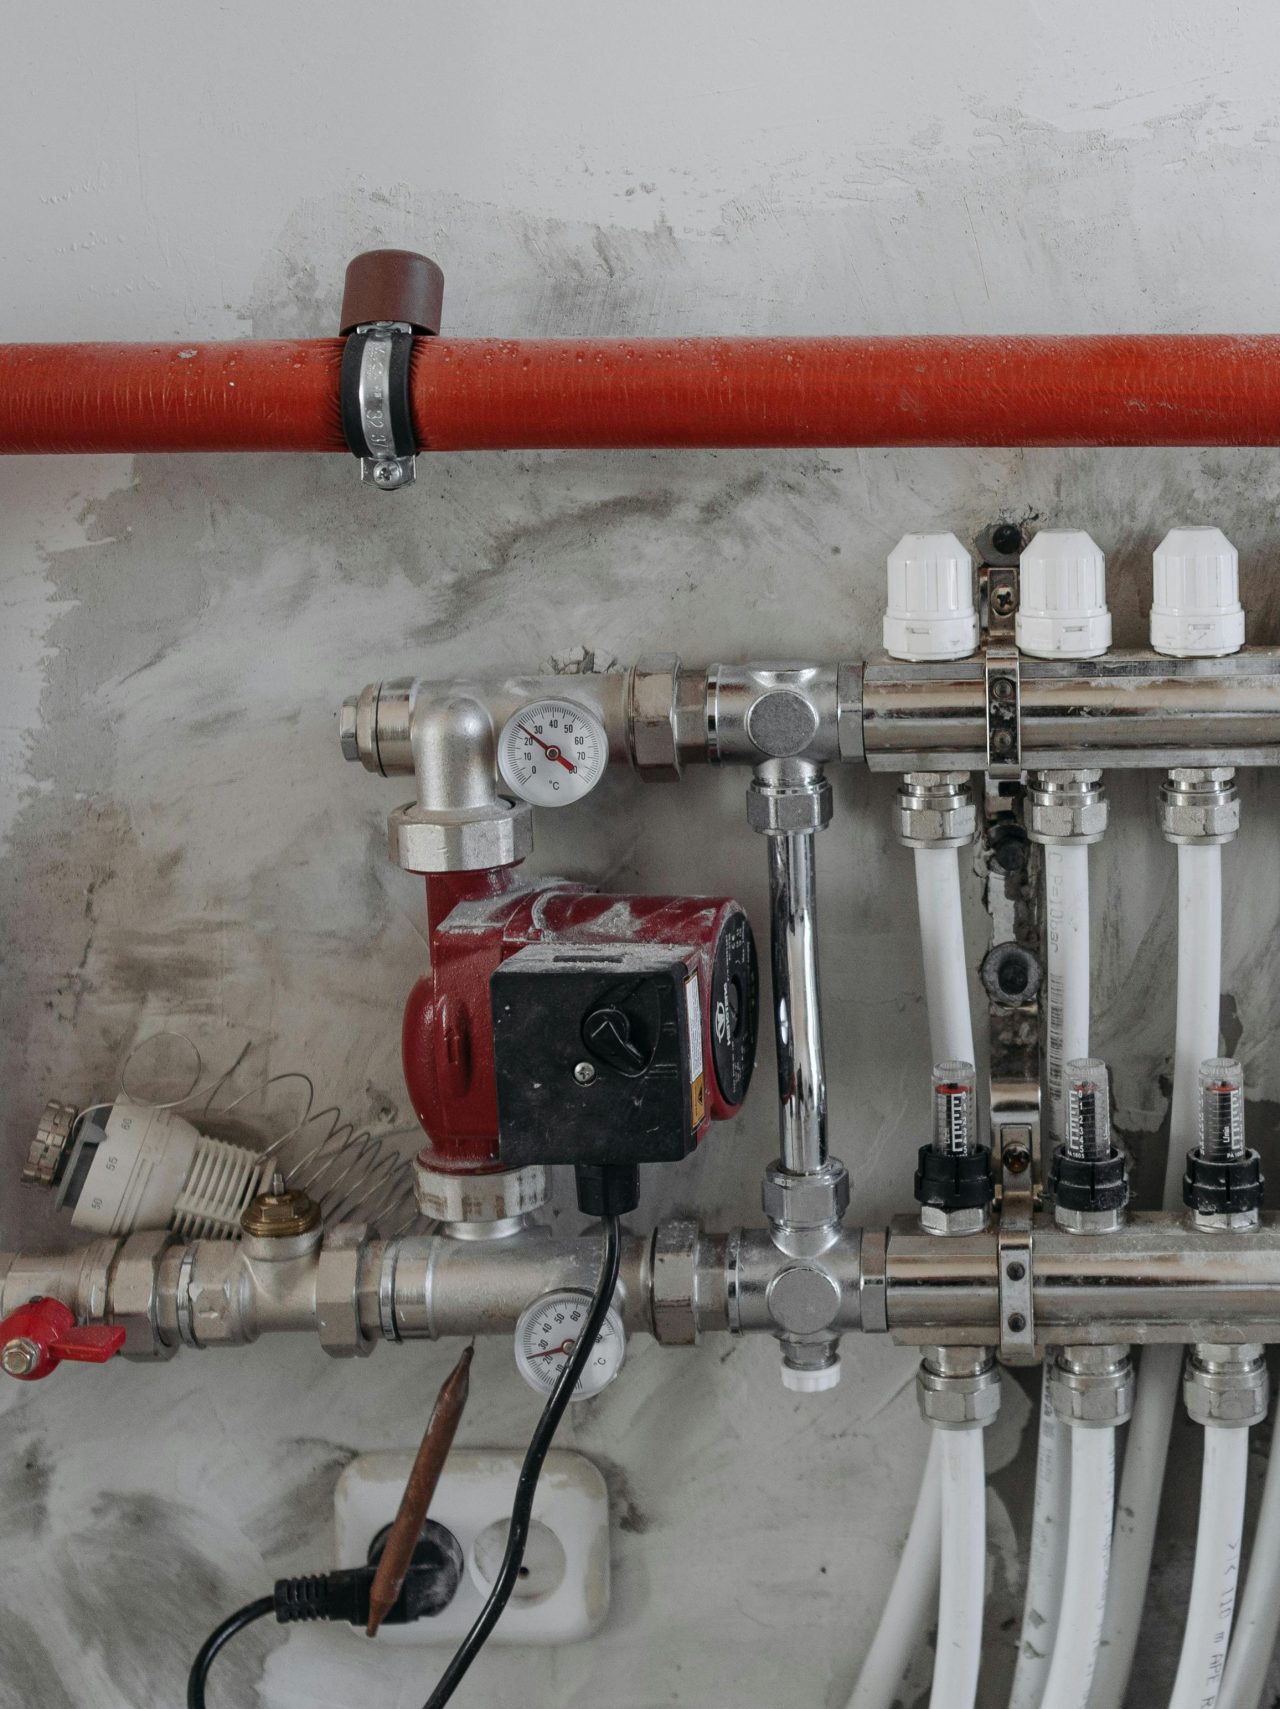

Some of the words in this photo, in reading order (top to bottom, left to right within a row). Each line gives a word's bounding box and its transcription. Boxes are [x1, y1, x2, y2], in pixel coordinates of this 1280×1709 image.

[549, 719, 558, 729] 40
[564, 724, 573, 734] 50
[534, 725, 543, 735] 30
[524, 737, 533, 746] 20
[575, 736, 584, 745] 60
[524, 752, 532, 761] 10
[577, 752, 586, 761] 70
[532, 765, 537, 775] 0
[121, 1118, 133, 1131] 60
[105, 1156, 118, 1171] 55
[91, 1197, 103, 1210] 50
[554, 1313, 565, 1325] 50
[570, 1310, 581, 1322] 60
[542, 1323, 552, 1334] 40
[537, 1339, 549, 1350] 30
[543, 1354, 554, 1365] 20
